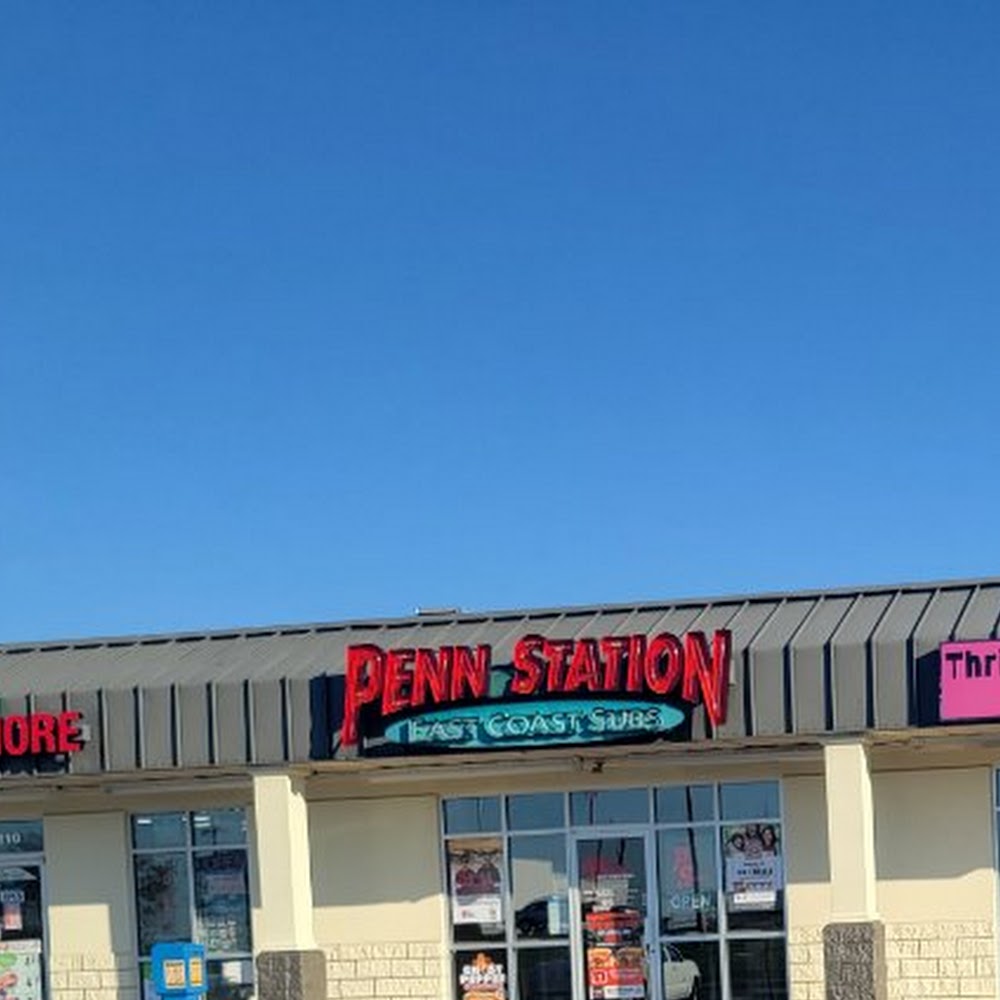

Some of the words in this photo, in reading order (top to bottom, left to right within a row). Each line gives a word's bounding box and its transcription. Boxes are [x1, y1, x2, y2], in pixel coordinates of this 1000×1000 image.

[340, 643, 492, 747] PENN
[511, 628, 732, 726] STATION
[408, 717, 479, 742] EAST
[485, 712, 581, 738] COAST
[588, 707, 664, 731] SUBS
[671, 893, 711, 909] OPEN
